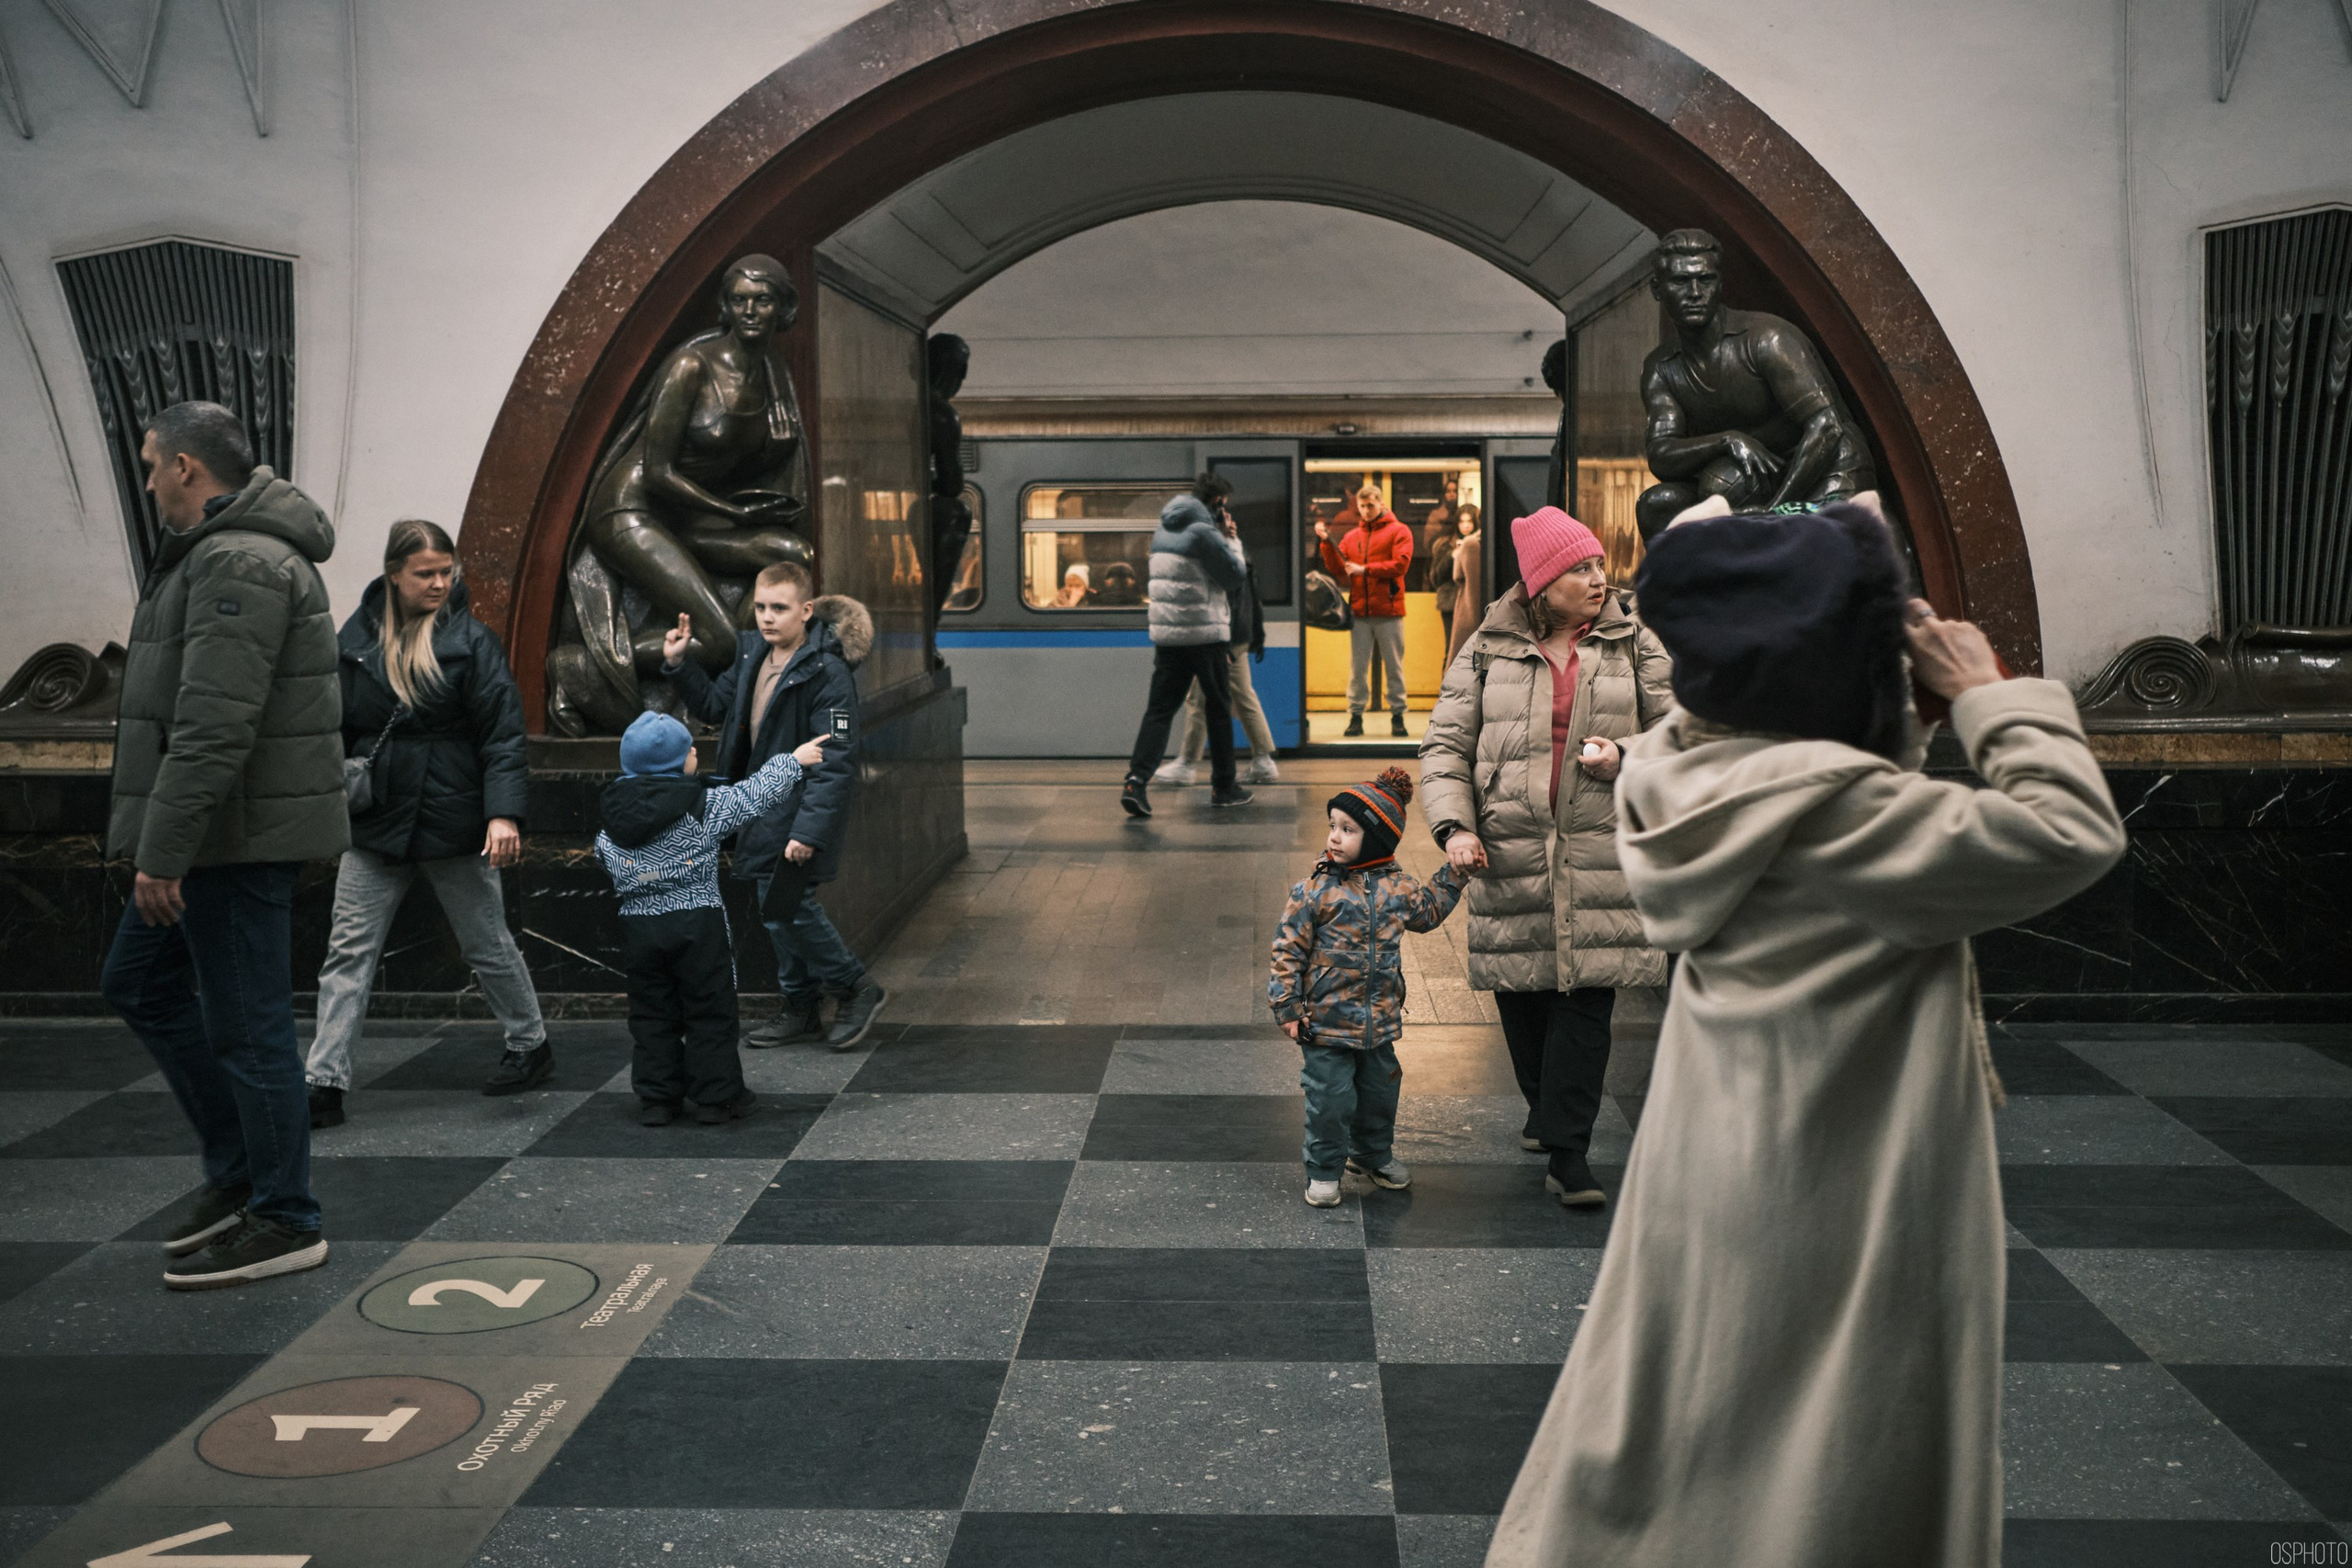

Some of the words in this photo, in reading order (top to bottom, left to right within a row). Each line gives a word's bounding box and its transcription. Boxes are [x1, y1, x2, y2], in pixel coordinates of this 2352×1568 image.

[408, 1279, 546, 1308] 2
[580, 1264, 654, 1329] Театральная
[270, 1407, 421, 1442] 1
[457, 1410, 531, 1471] Охотный
[513, 1383, 560, 1406] Ряд
[511, 1417, 555, 1452] Okhotny
